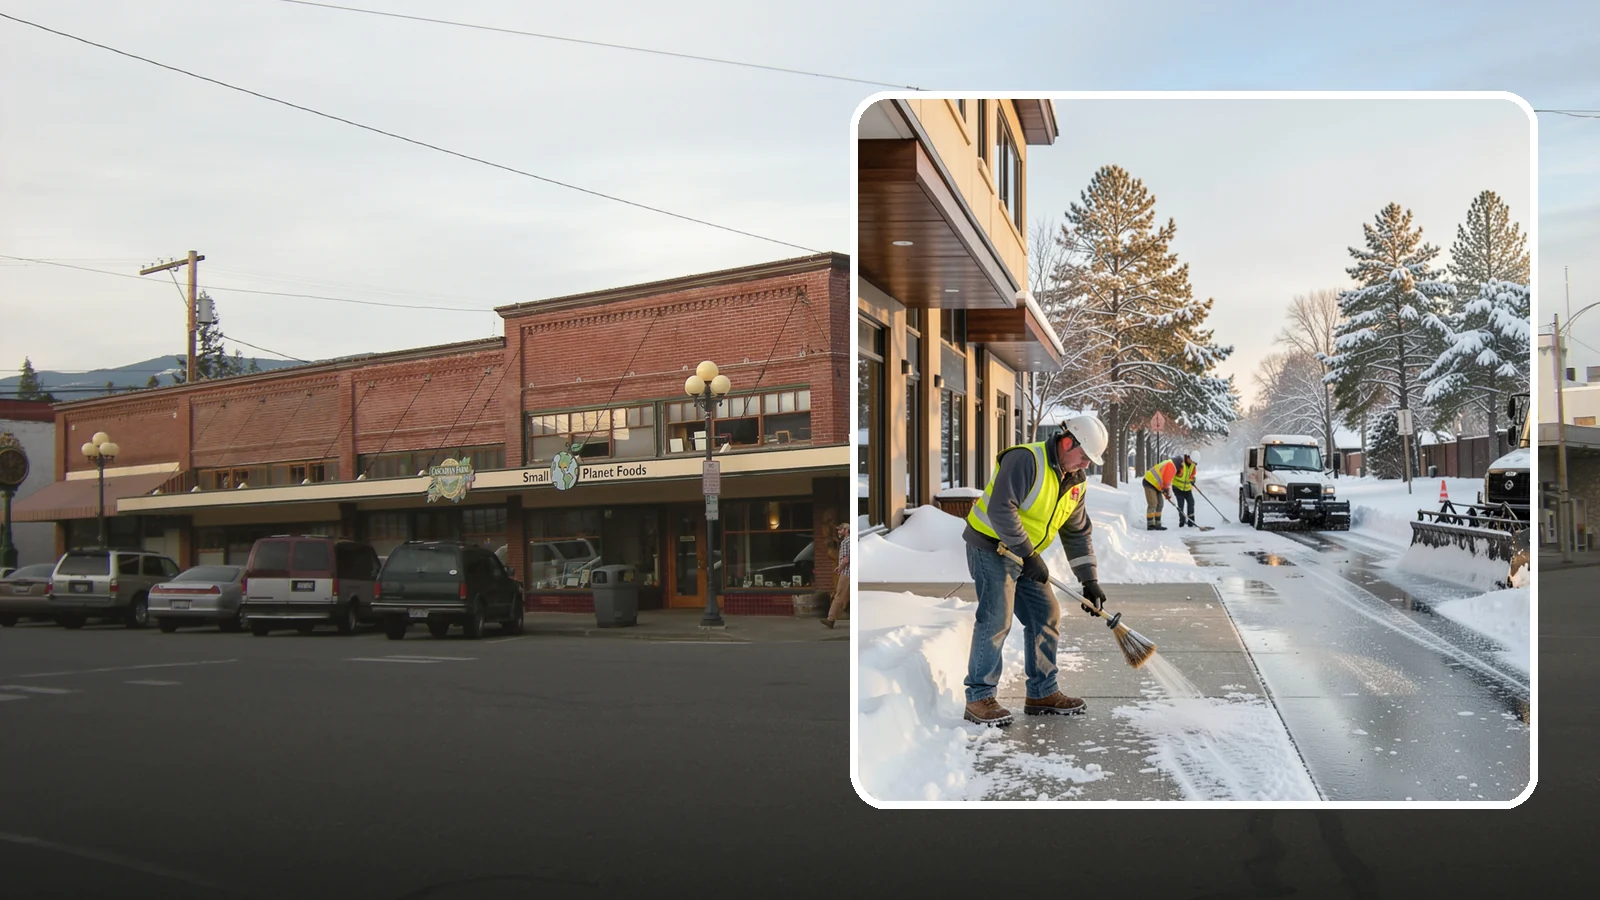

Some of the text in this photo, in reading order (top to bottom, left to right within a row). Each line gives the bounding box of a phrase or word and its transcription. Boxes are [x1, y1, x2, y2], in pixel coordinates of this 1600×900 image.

[523, 464, 647, 483] Small Planet Foods
